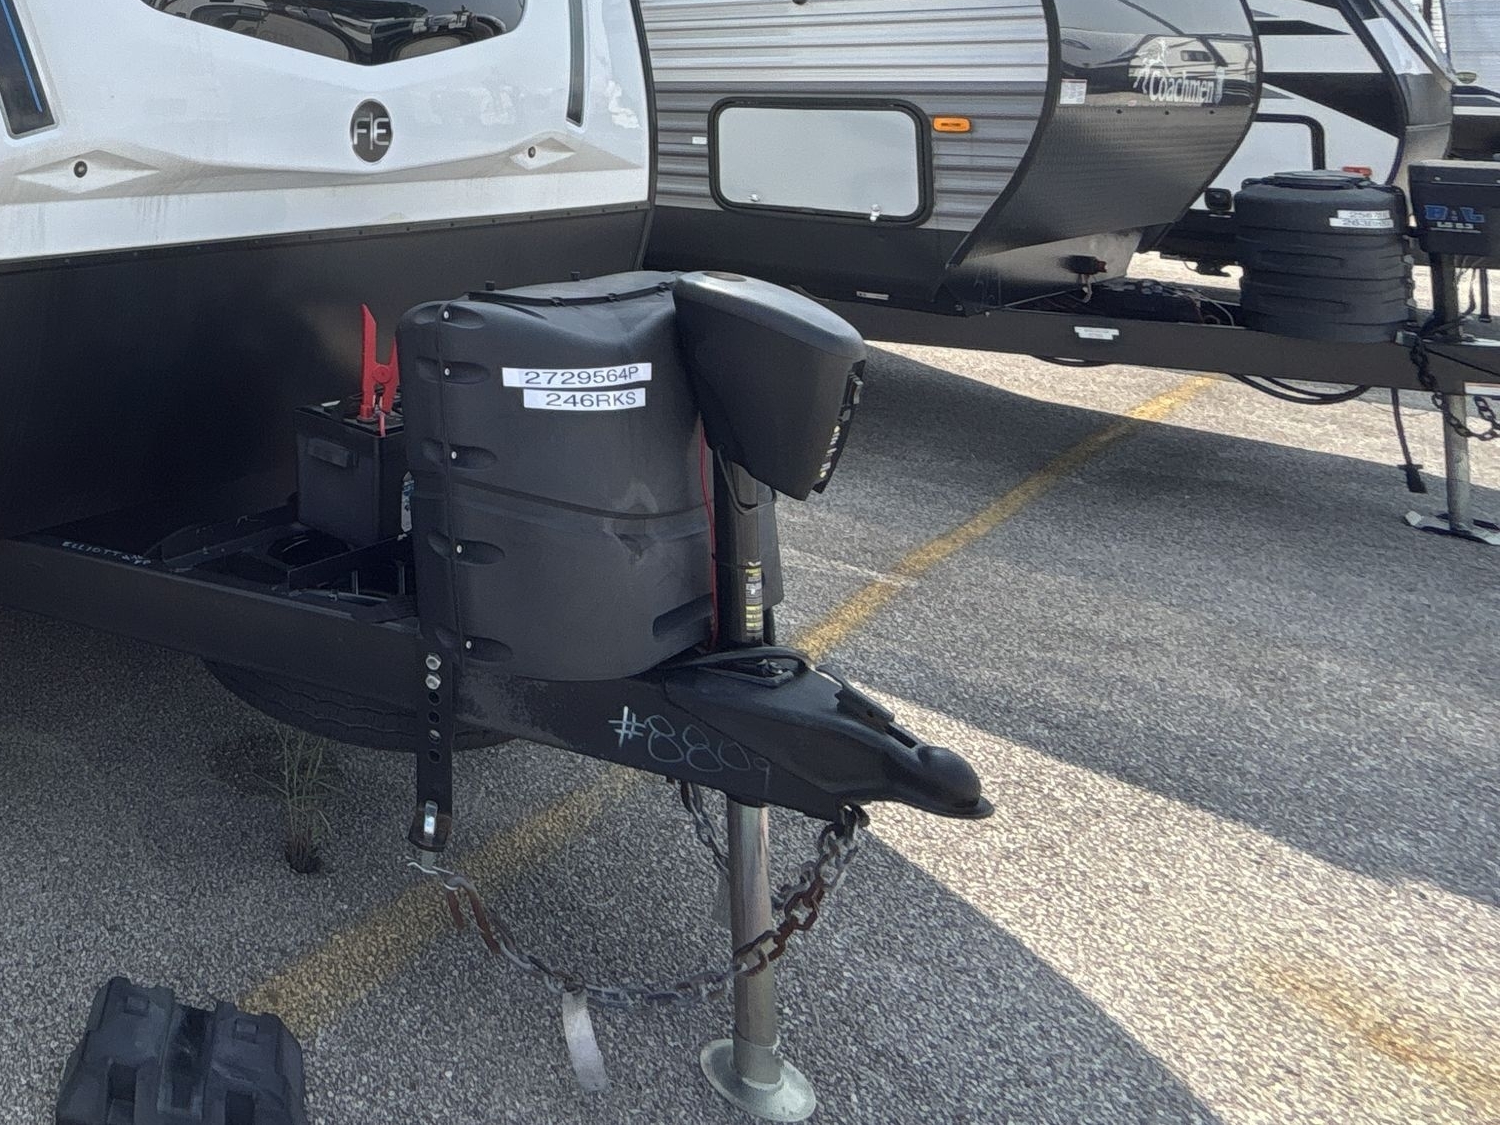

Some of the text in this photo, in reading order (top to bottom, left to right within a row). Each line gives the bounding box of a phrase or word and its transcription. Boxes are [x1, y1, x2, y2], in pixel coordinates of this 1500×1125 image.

[1148, 69, 1215, 104] Coachmen
[524, 365, 639, 385] 2729564P
[545, 391, 637, 408] 246RKS
[61, 541, 123, 557] ELLIOTT
[608, 705, 772, 796] #8809
